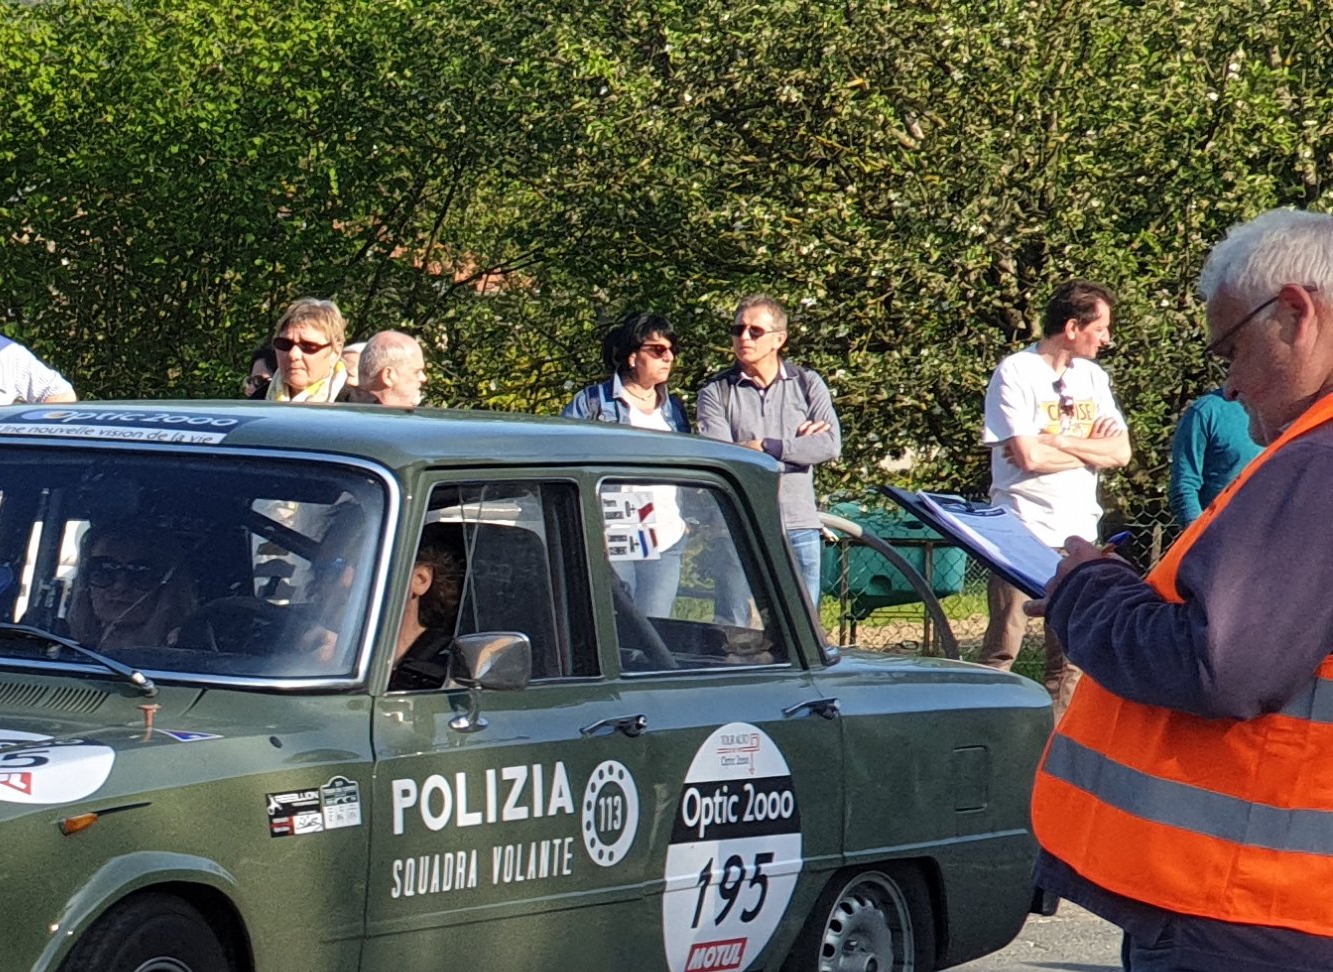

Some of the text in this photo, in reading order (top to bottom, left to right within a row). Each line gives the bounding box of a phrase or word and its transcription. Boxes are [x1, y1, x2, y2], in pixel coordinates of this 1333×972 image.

[29, 425, 95, 436] nouvelle
[99, 428, 143, 438] vision
[147, 430, 168, 440] de
[170, 432, 183, 442] la
[190, 434, 214, 443] vie
[139, 413, 238, 426] 2000
[391, 761, 574, 835] POLIZIA
[598, 795, 623, 832] 113
[682, 783, 794, 838] Optic 2000
[391, 837, 574, 898] SQUADRA VOLANTE
[691, 852, 774, 929] 195
[688, 942, 742, 970] MOTUL
